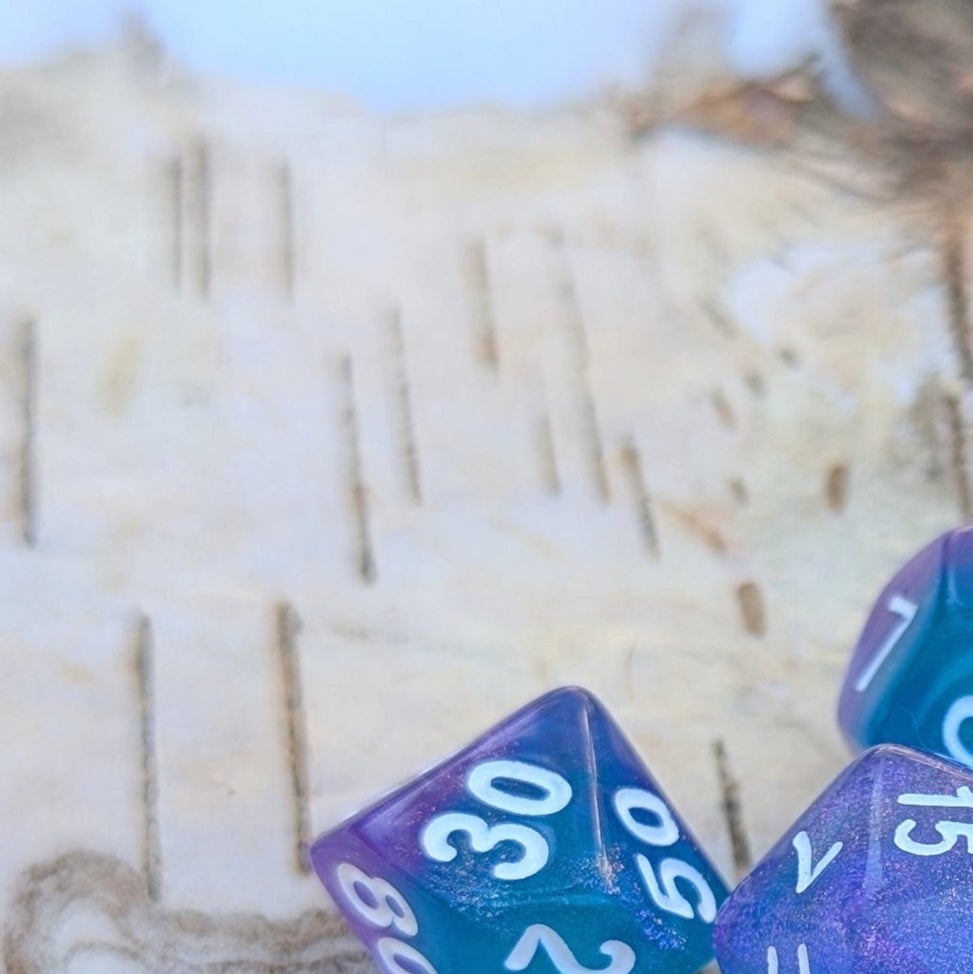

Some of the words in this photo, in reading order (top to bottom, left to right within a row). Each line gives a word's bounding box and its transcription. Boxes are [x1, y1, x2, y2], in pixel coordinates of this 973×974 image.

[420, 760, 572, 880] 30
[615, 788, 716, 923] 50
[793, 831, 843, 893] 7
